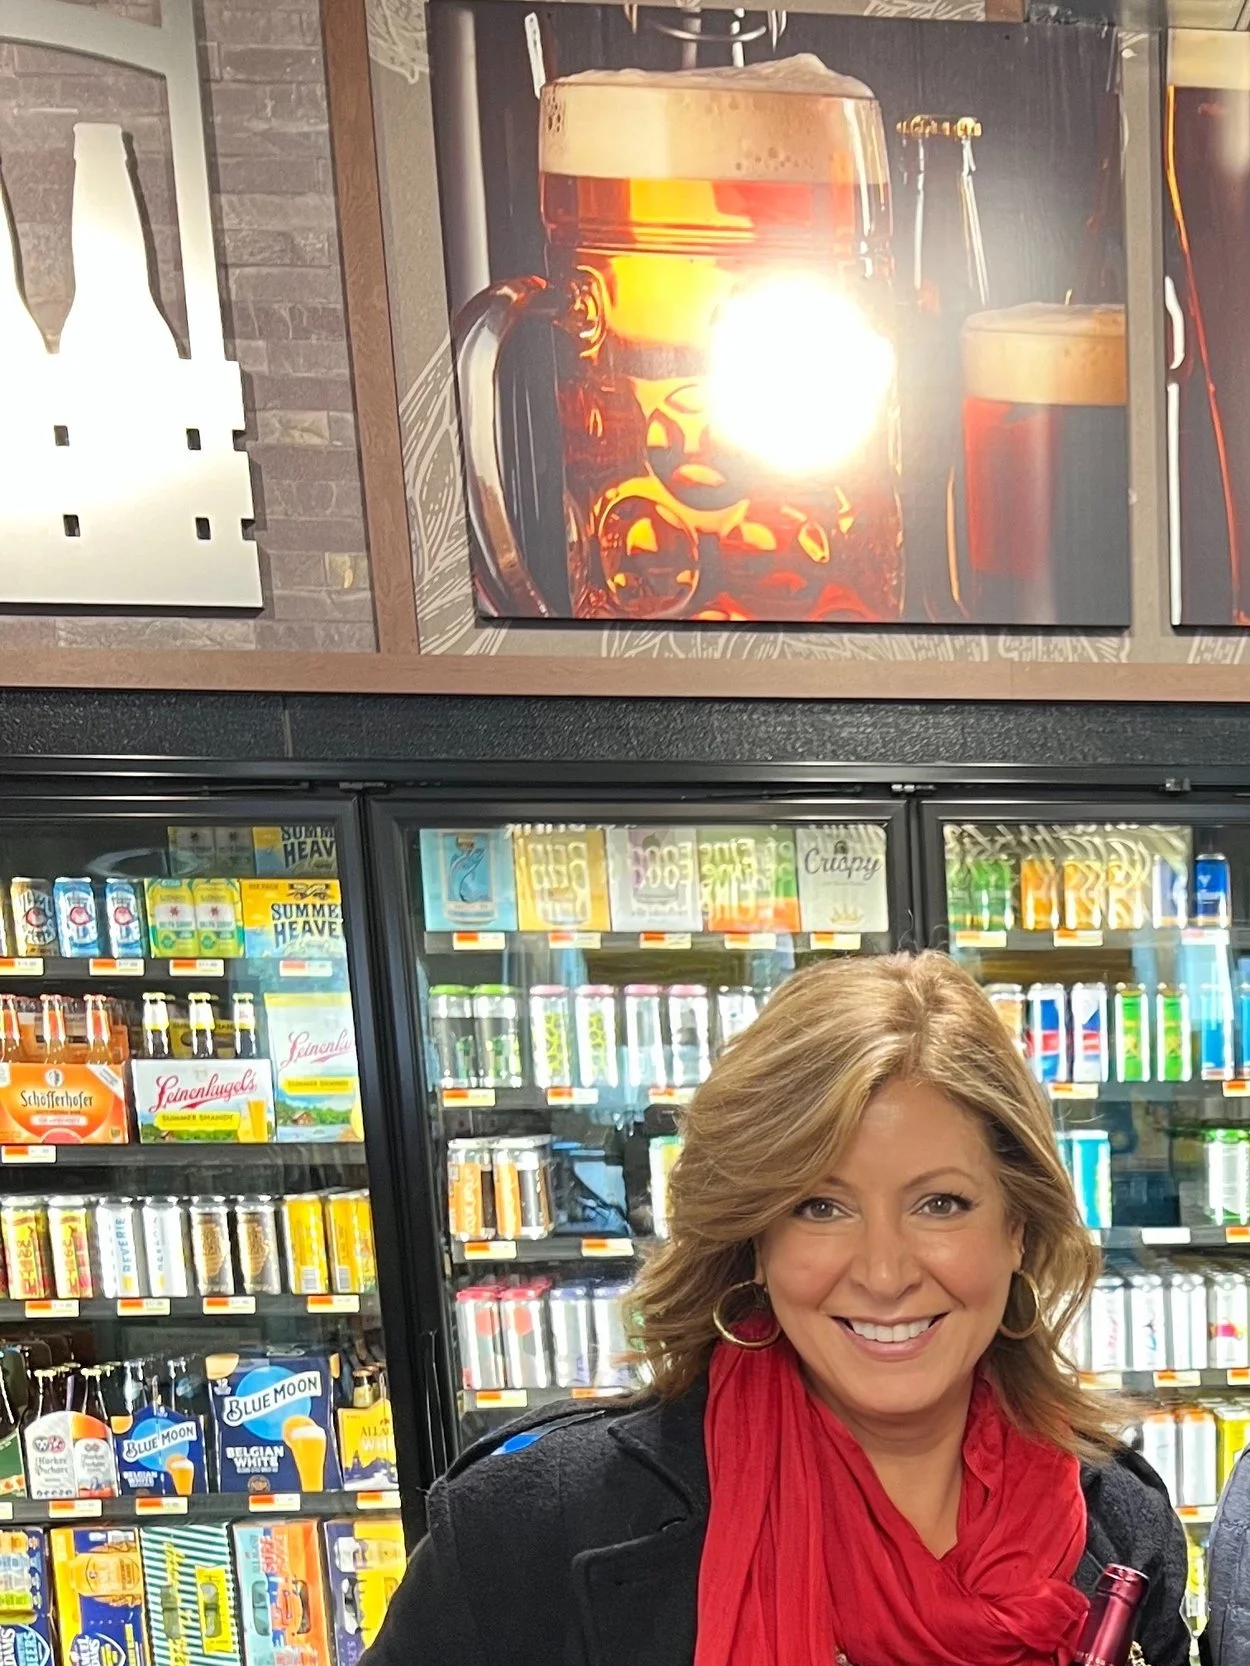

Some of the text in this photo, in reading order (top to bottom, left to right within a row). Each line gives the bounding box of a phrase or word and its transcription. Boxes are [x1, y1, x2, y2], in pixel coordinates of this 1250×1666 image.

[226, 1376, 319, 1423] BLUE MOON
[125, 1426, 195, 1459] BLUE MOON
[226, 1446, 285, 1460] BELGIAN
[234, 1457, 279, 1469] WHITE
